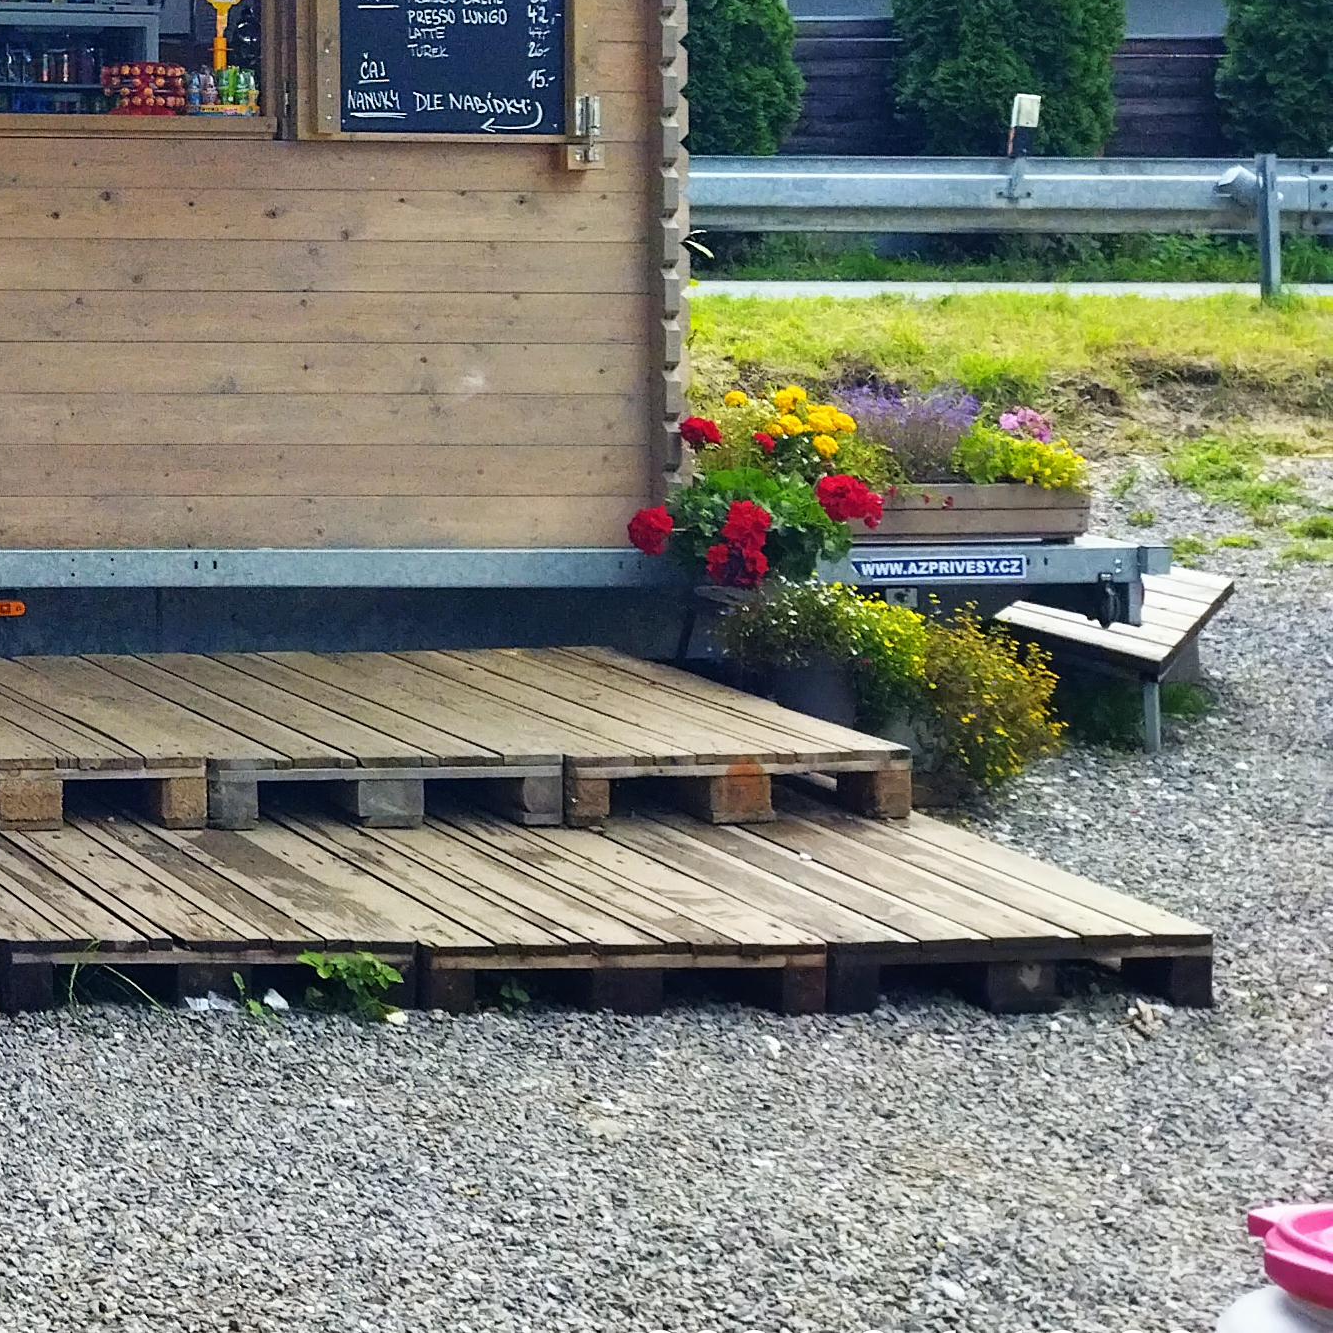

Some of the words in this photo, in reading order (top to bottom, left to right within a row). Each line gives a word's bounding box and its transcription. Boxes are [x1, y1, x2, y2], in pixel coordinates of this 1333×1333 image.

[408, 9, 456, 25] PRESSO
[462, 9, 508, 25] LUNGO
[408, 27, 446, 40] LATTE
[407, 44, 449, 58] TUREK
[359, 52, 387, 80] ČAJ
[347, 89, 400, 109] NANUKY
[413, 91, 444, 112] DLE
[861, 560, 1021, 576] WWW.AZPRIVESY.CZ
